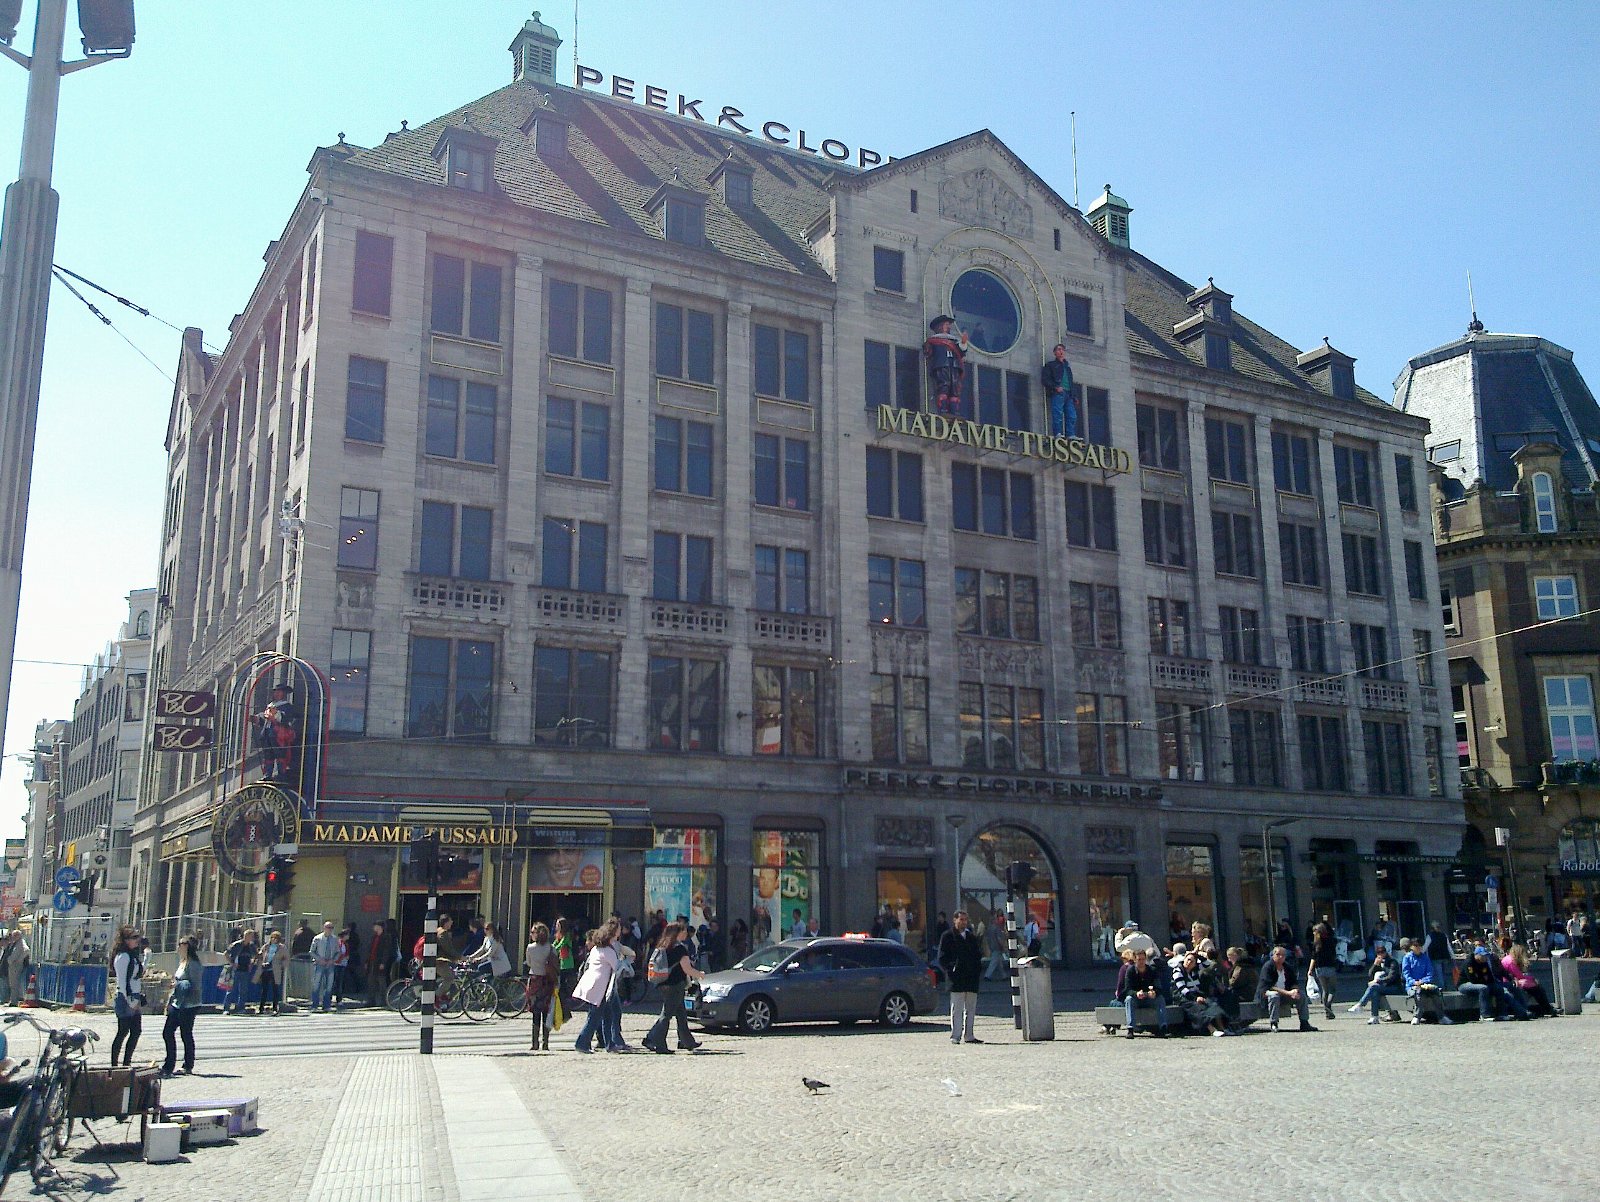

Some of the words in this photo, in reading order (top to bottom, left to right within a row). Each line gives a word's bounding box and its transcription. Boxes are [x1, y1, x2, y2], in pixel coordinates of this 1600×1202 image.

[576, 64, 705, 121] PEEK
[717, 105, 753, 134] &
[762, 121, 899, 169] CLOP
[877, 404, 1011, 453] MADAME
[1017, 430, 1134, 475] TUSSAUD
[845, 769, 920, 789] PEEK
[956, 776, 1164, 800] CLOPPENBURG
[314, 824, 412, 843] MADAME
[423, 826, 519, 845] TUSSAUD
